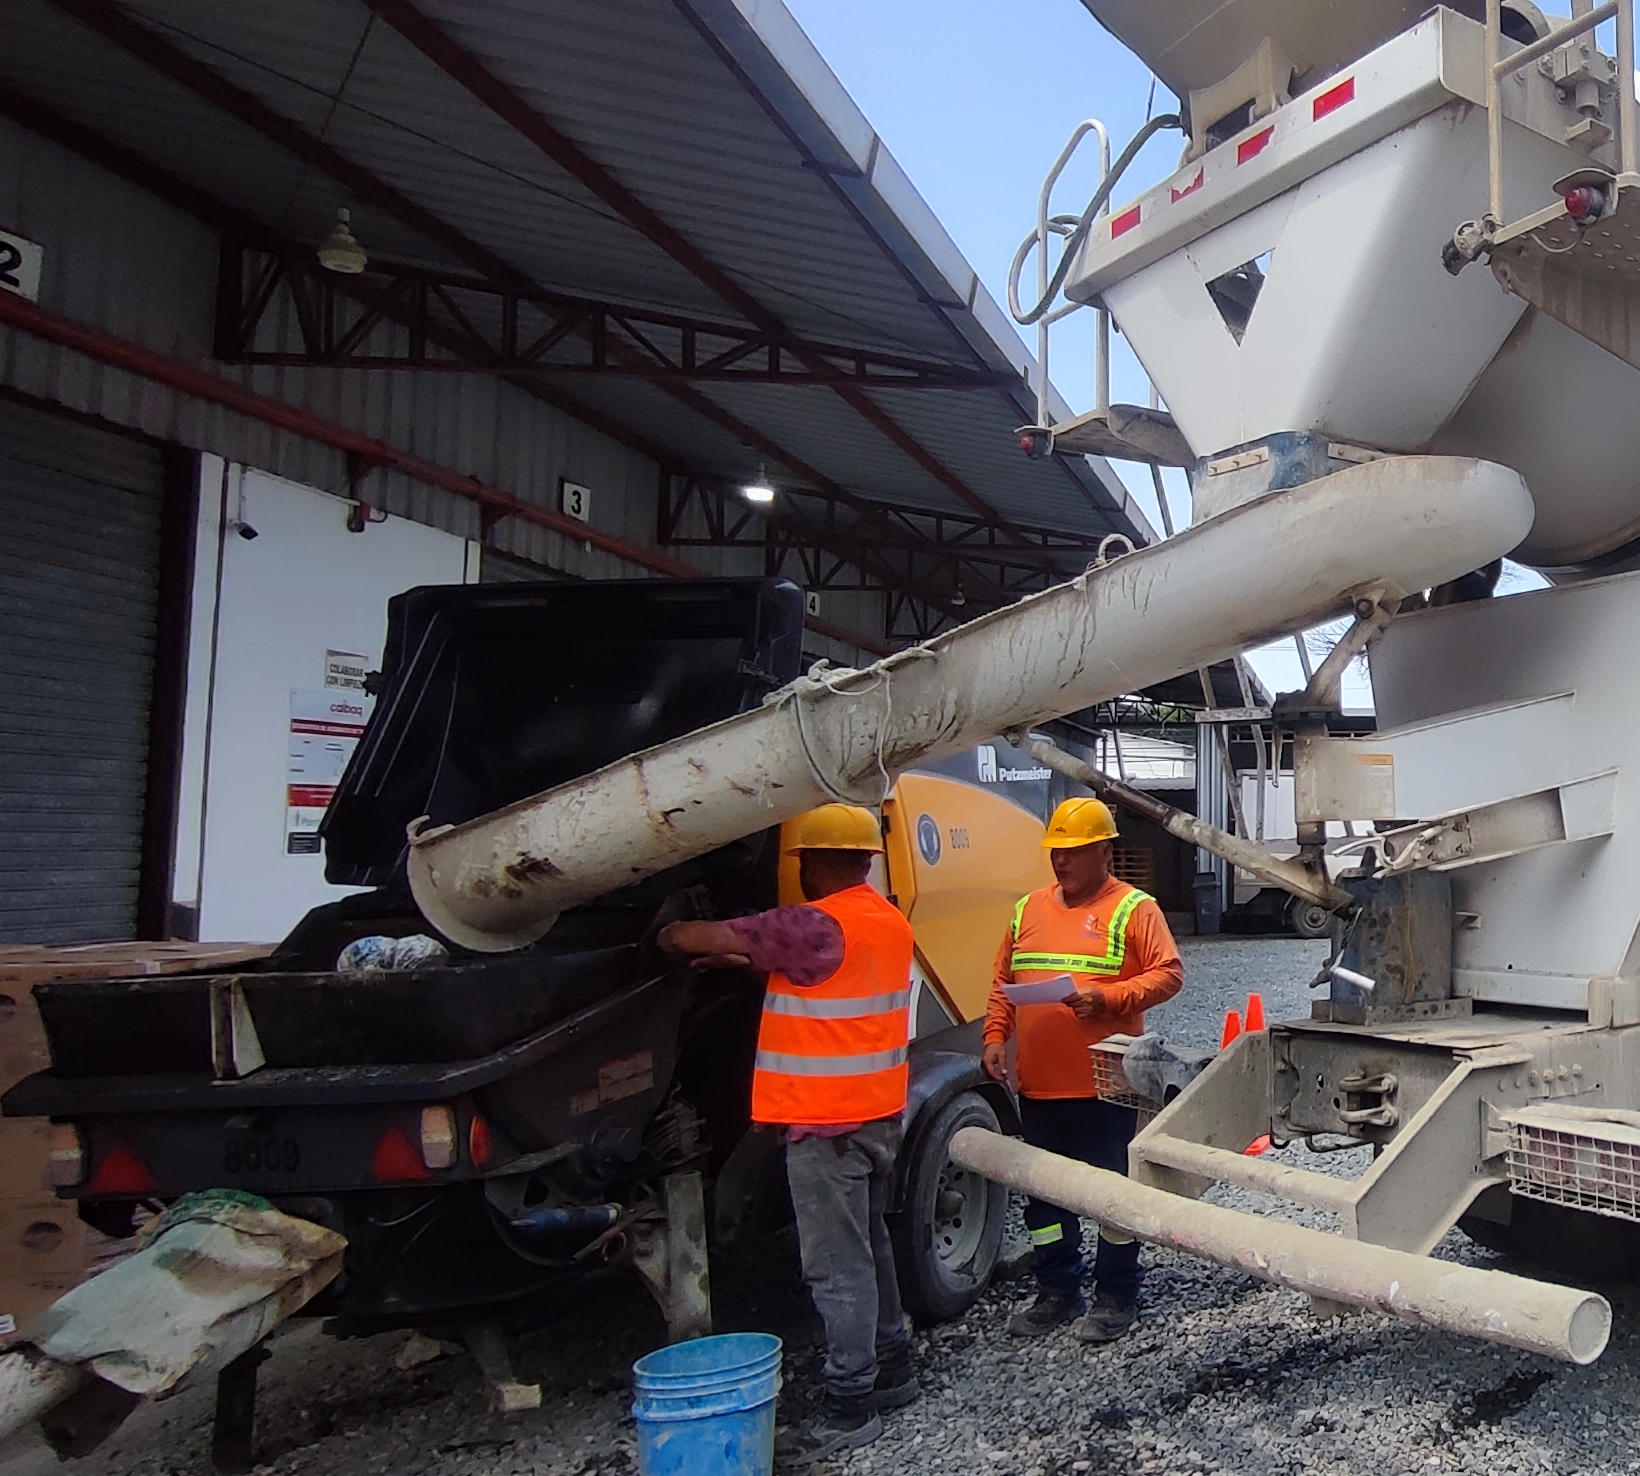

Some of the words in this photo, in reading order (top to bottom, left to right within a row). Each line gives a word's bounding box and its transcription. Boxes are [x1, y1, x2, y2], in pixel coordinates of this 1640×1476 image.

[0, 241, 22, 287] 2
[571, 490, 582, 515] 3
[809, 595, 816, 613] 4
[341, 678, 364, 689] LIMPIEZ
[999, 766, 1052, 782] Putzmeister
[223, 1137, 301, 1174] 8009
